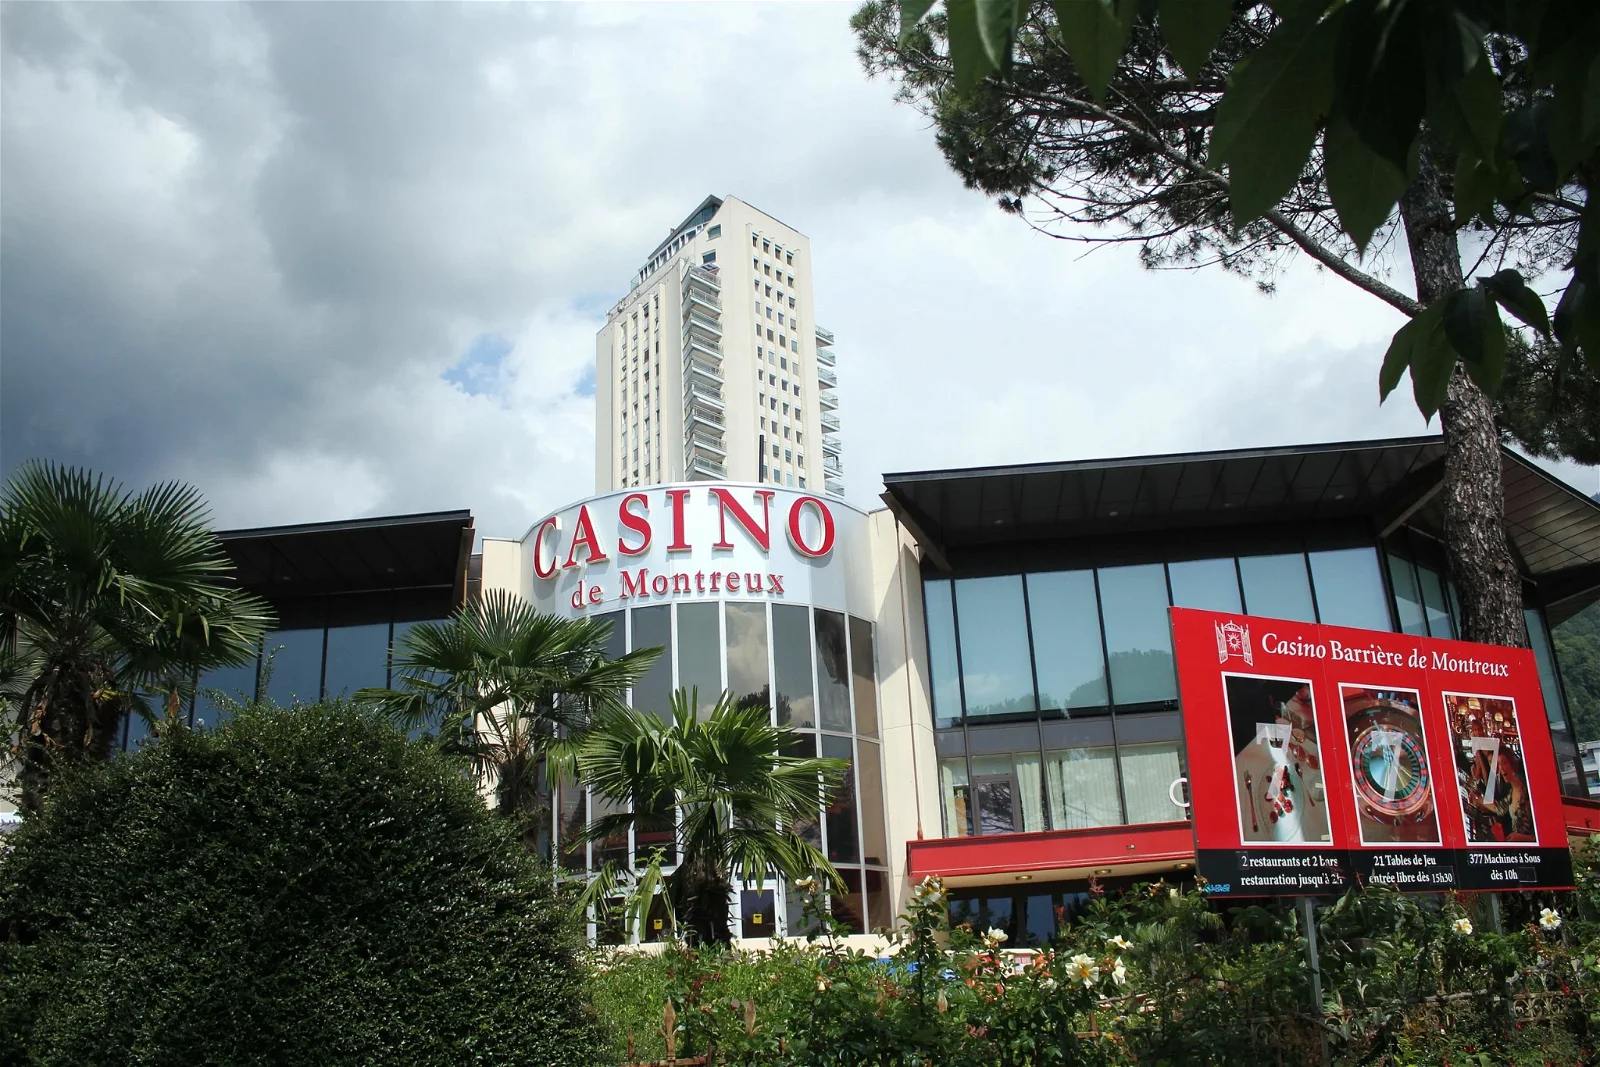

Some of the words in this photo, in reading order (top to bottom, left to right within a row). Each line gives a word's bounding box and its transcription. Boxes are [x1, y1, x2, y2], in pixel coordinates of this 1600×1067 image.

[533, 488, 836, 580] CASINO
[571, 580, 603, 609] de
[620, 568, 785, 599] Montreux
[1261, 632, 1326, 659] Casino
[1329, 640, 1403, 667] Barrière
[1408, 648, 1427, 670] de
[1431, 651, 1509, 677] Montreux
[1370, 730, 1403, 802] 7
[1470, 736, 1500, 805] 7
[1241, 855, 1249, 867] 2
[1249, 856, 1301, 867] restaurants
[1301, 856, 1311, 867] et
[1312, 855, 1319, 867] 2
[1373, 855, 1385, 866] 21
[1385, 854, 1412, 866] Tables
[1412, 854, 1423, 866] de
[1423, 854, 1437, 867] Jeu
[1469, 853, 1483, 864] 377
[1484, 853, 1518, 864] Machines
[1519, 853, 1524, 864] à
[1524, 853, 1541, 864] Sous
[1241, 873, 1298, 886] restauration
[1298, 872, 1331, 888] jusqu'à
[1368, 871, 1396, 884] entrée
[1396, 871, 1416, 883] libre
[1416, 871, 1430, 883] dès
[1432, 872, 1453, 883] 15h30
[1490, 869, 1504, 881] dès
[1504, 869, 1518, 881] 10h
